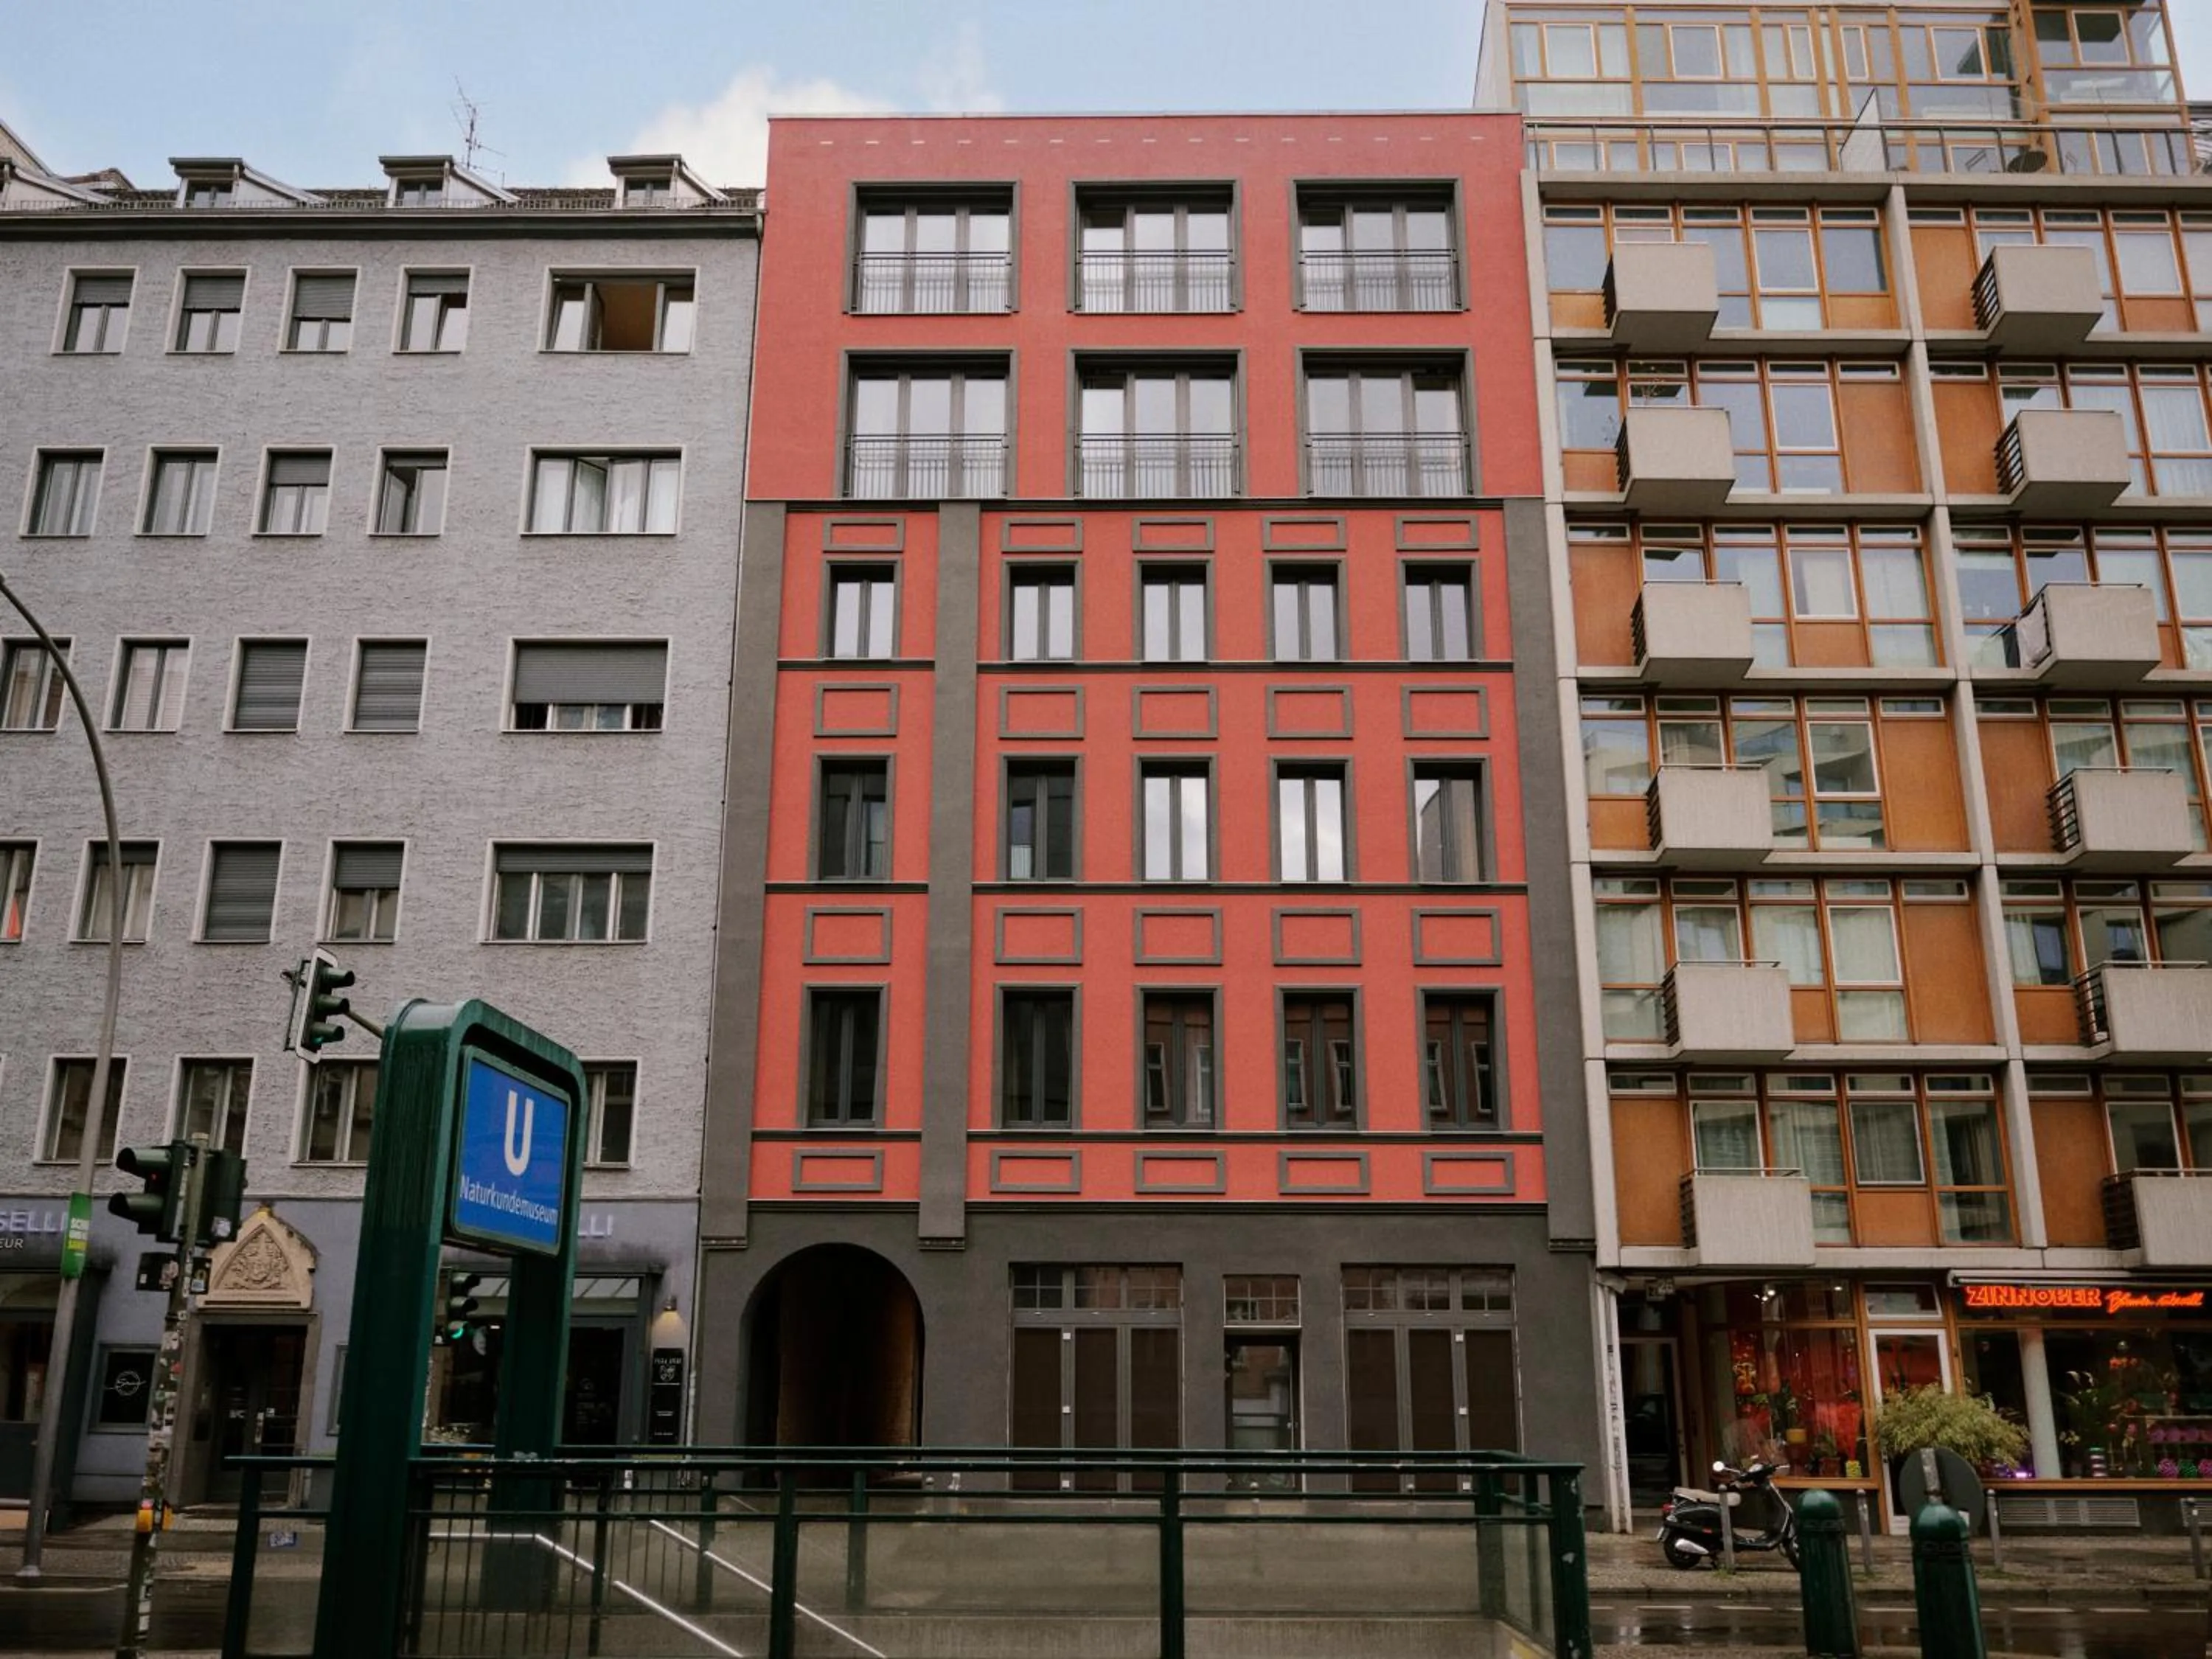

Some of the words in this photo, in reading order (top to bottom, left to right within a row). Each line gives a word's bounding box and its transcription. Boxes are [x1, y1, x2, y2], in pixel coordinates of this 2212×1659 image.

[504, 1090, 535, 1177] U
[459, 1174, 558, 1225] Naturkundemuseum
[1966, 1284, 2102, 1307] ZINNOBER
